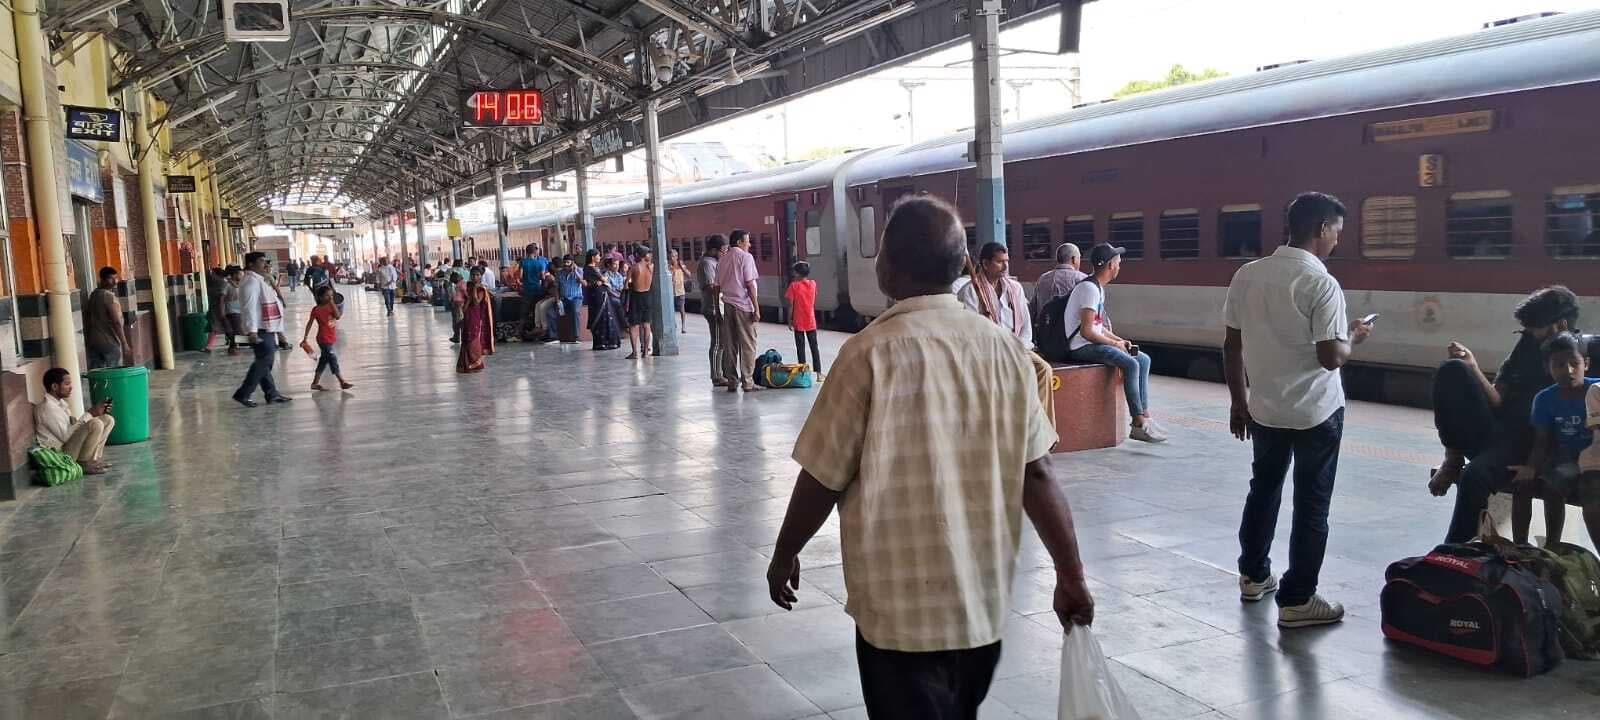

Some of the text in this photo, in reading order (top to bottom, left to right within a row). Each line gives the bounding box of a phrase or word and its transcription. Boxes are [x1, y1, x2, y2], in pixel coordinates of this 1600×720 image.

[71, 127, 115, 137] EXIT
[1436, 556, 1469, 568] ROYAL
[1449, 619, 1480, 629] ROYAL
